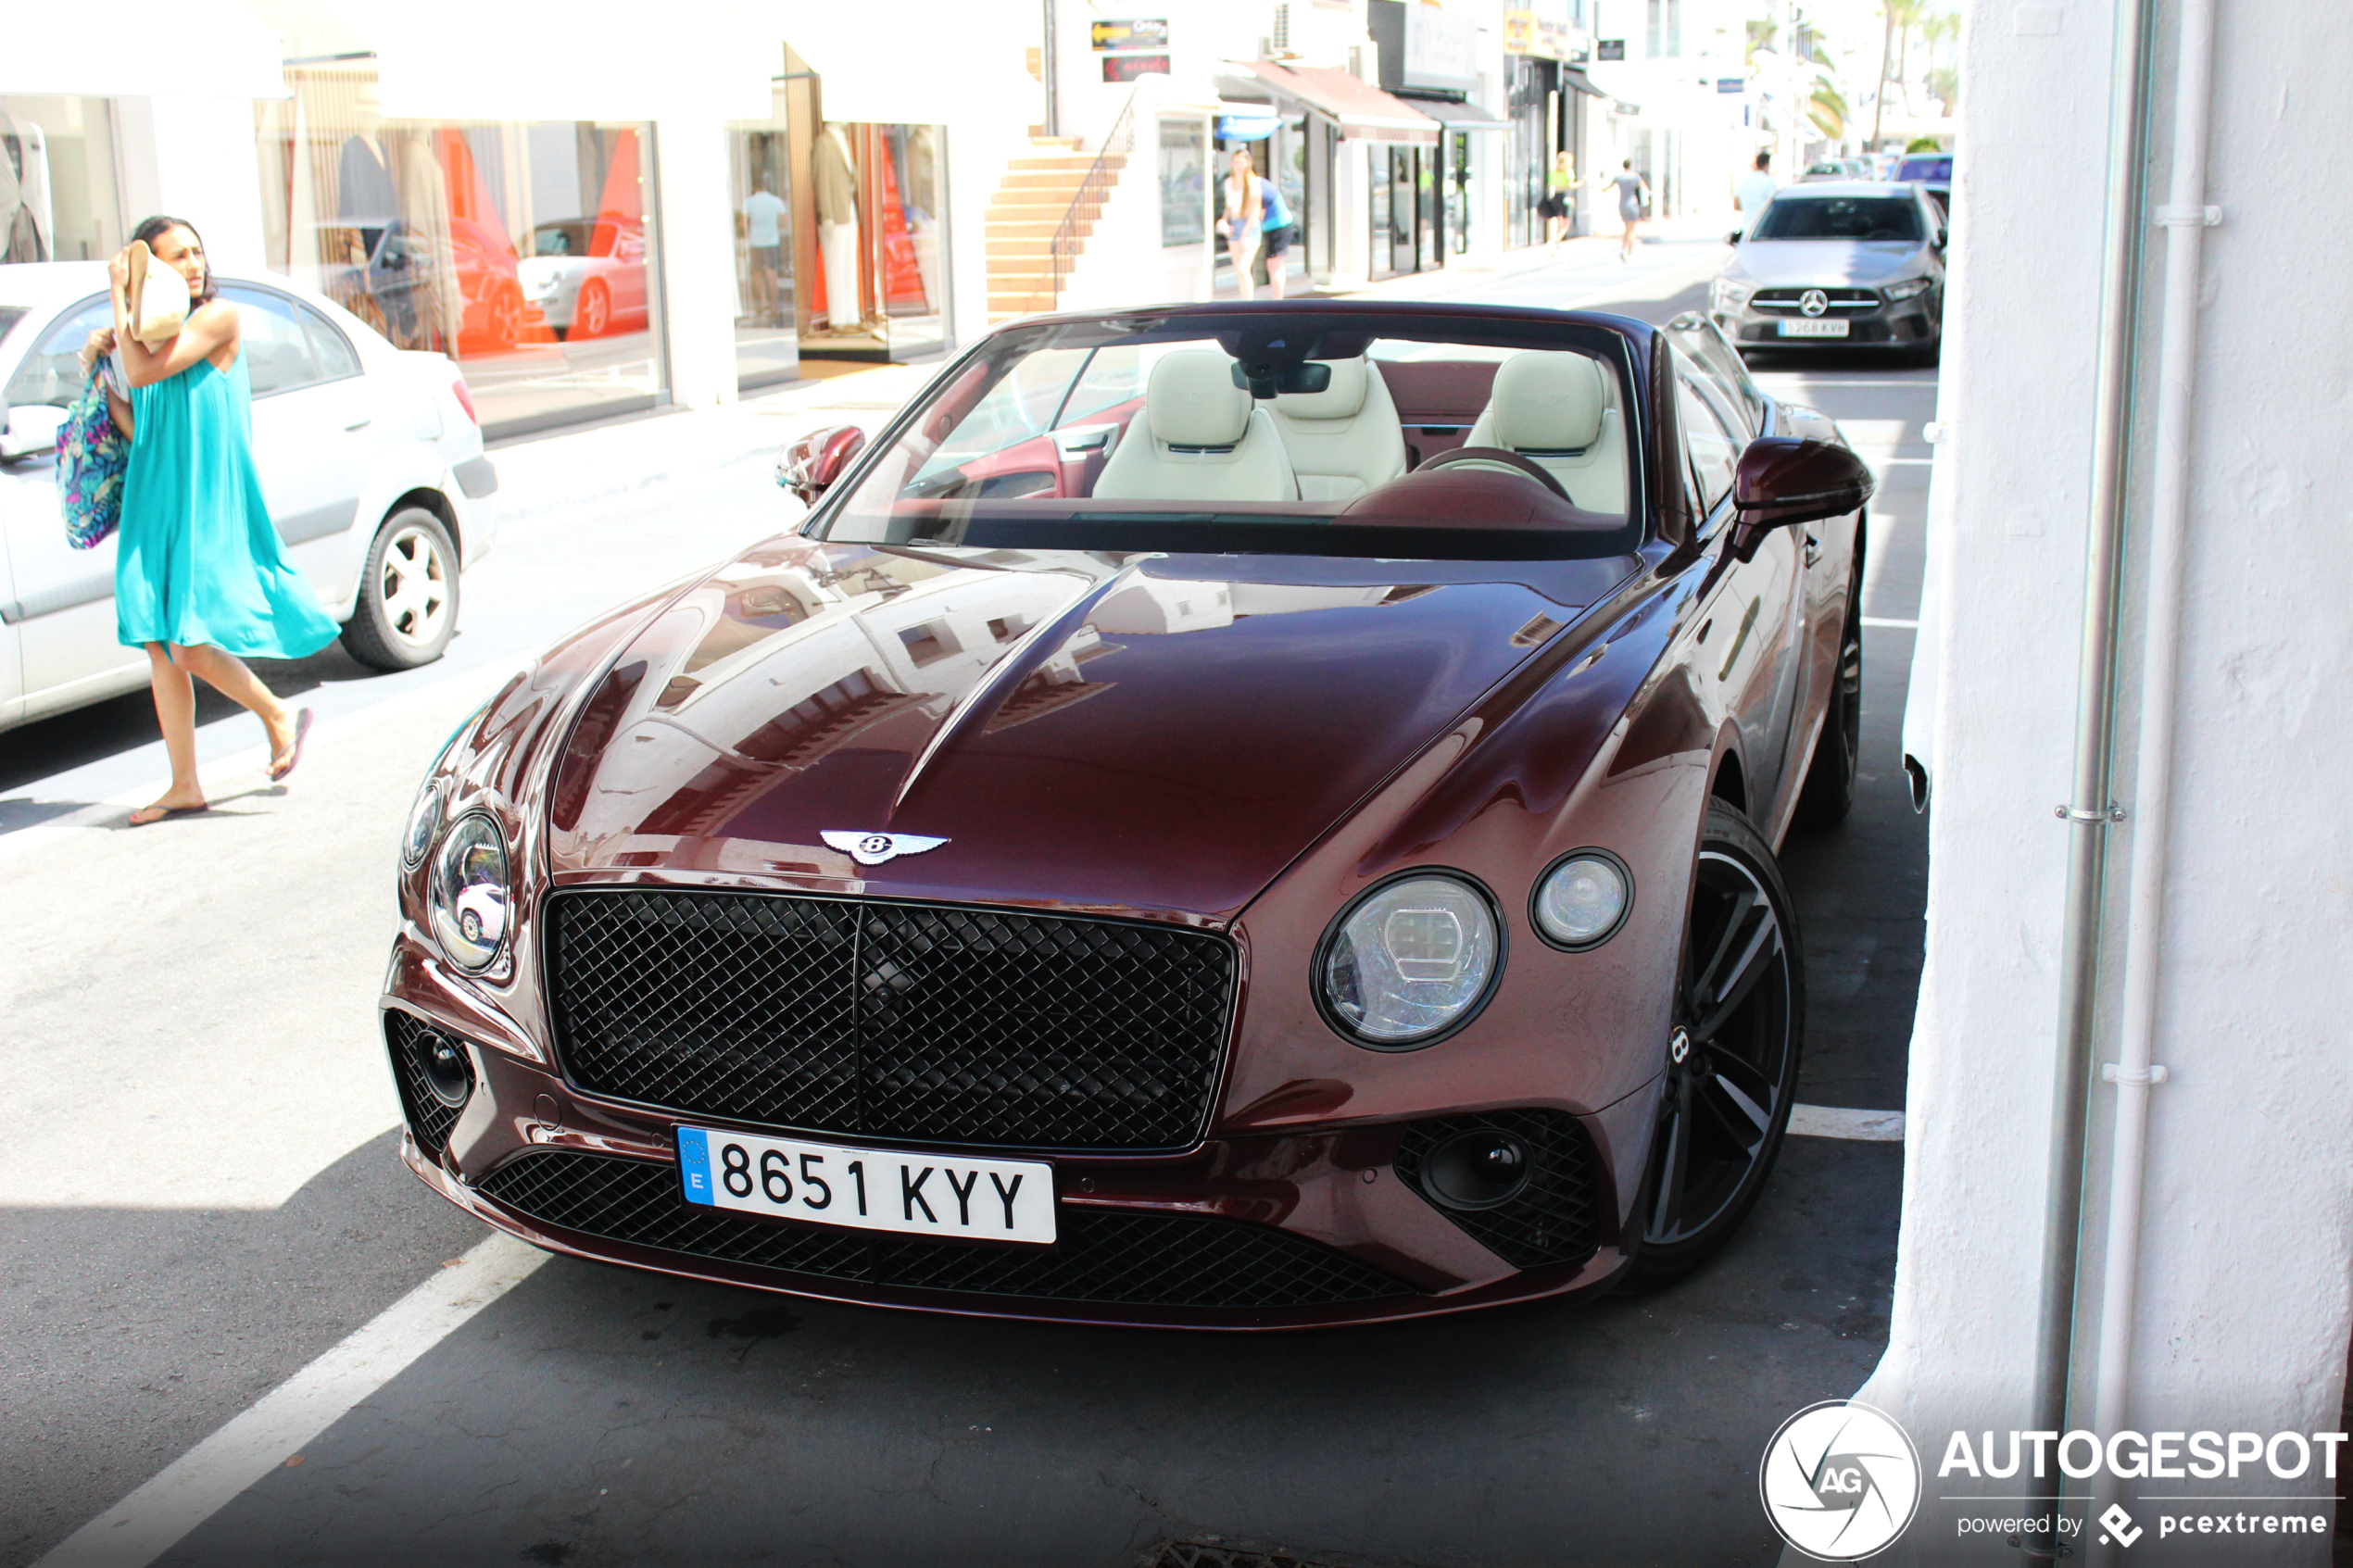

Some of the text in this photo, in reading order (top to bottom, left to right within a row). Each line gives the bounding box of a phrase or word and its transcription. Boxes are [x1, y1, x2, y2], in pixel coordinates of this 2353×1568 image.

[865, 836, 887, 853] B
[1671, 1031, 1690, 1064] B
[690, 1173, 704, 1189] E
[721, 1143, 1024, 1230] 8651 KYY
